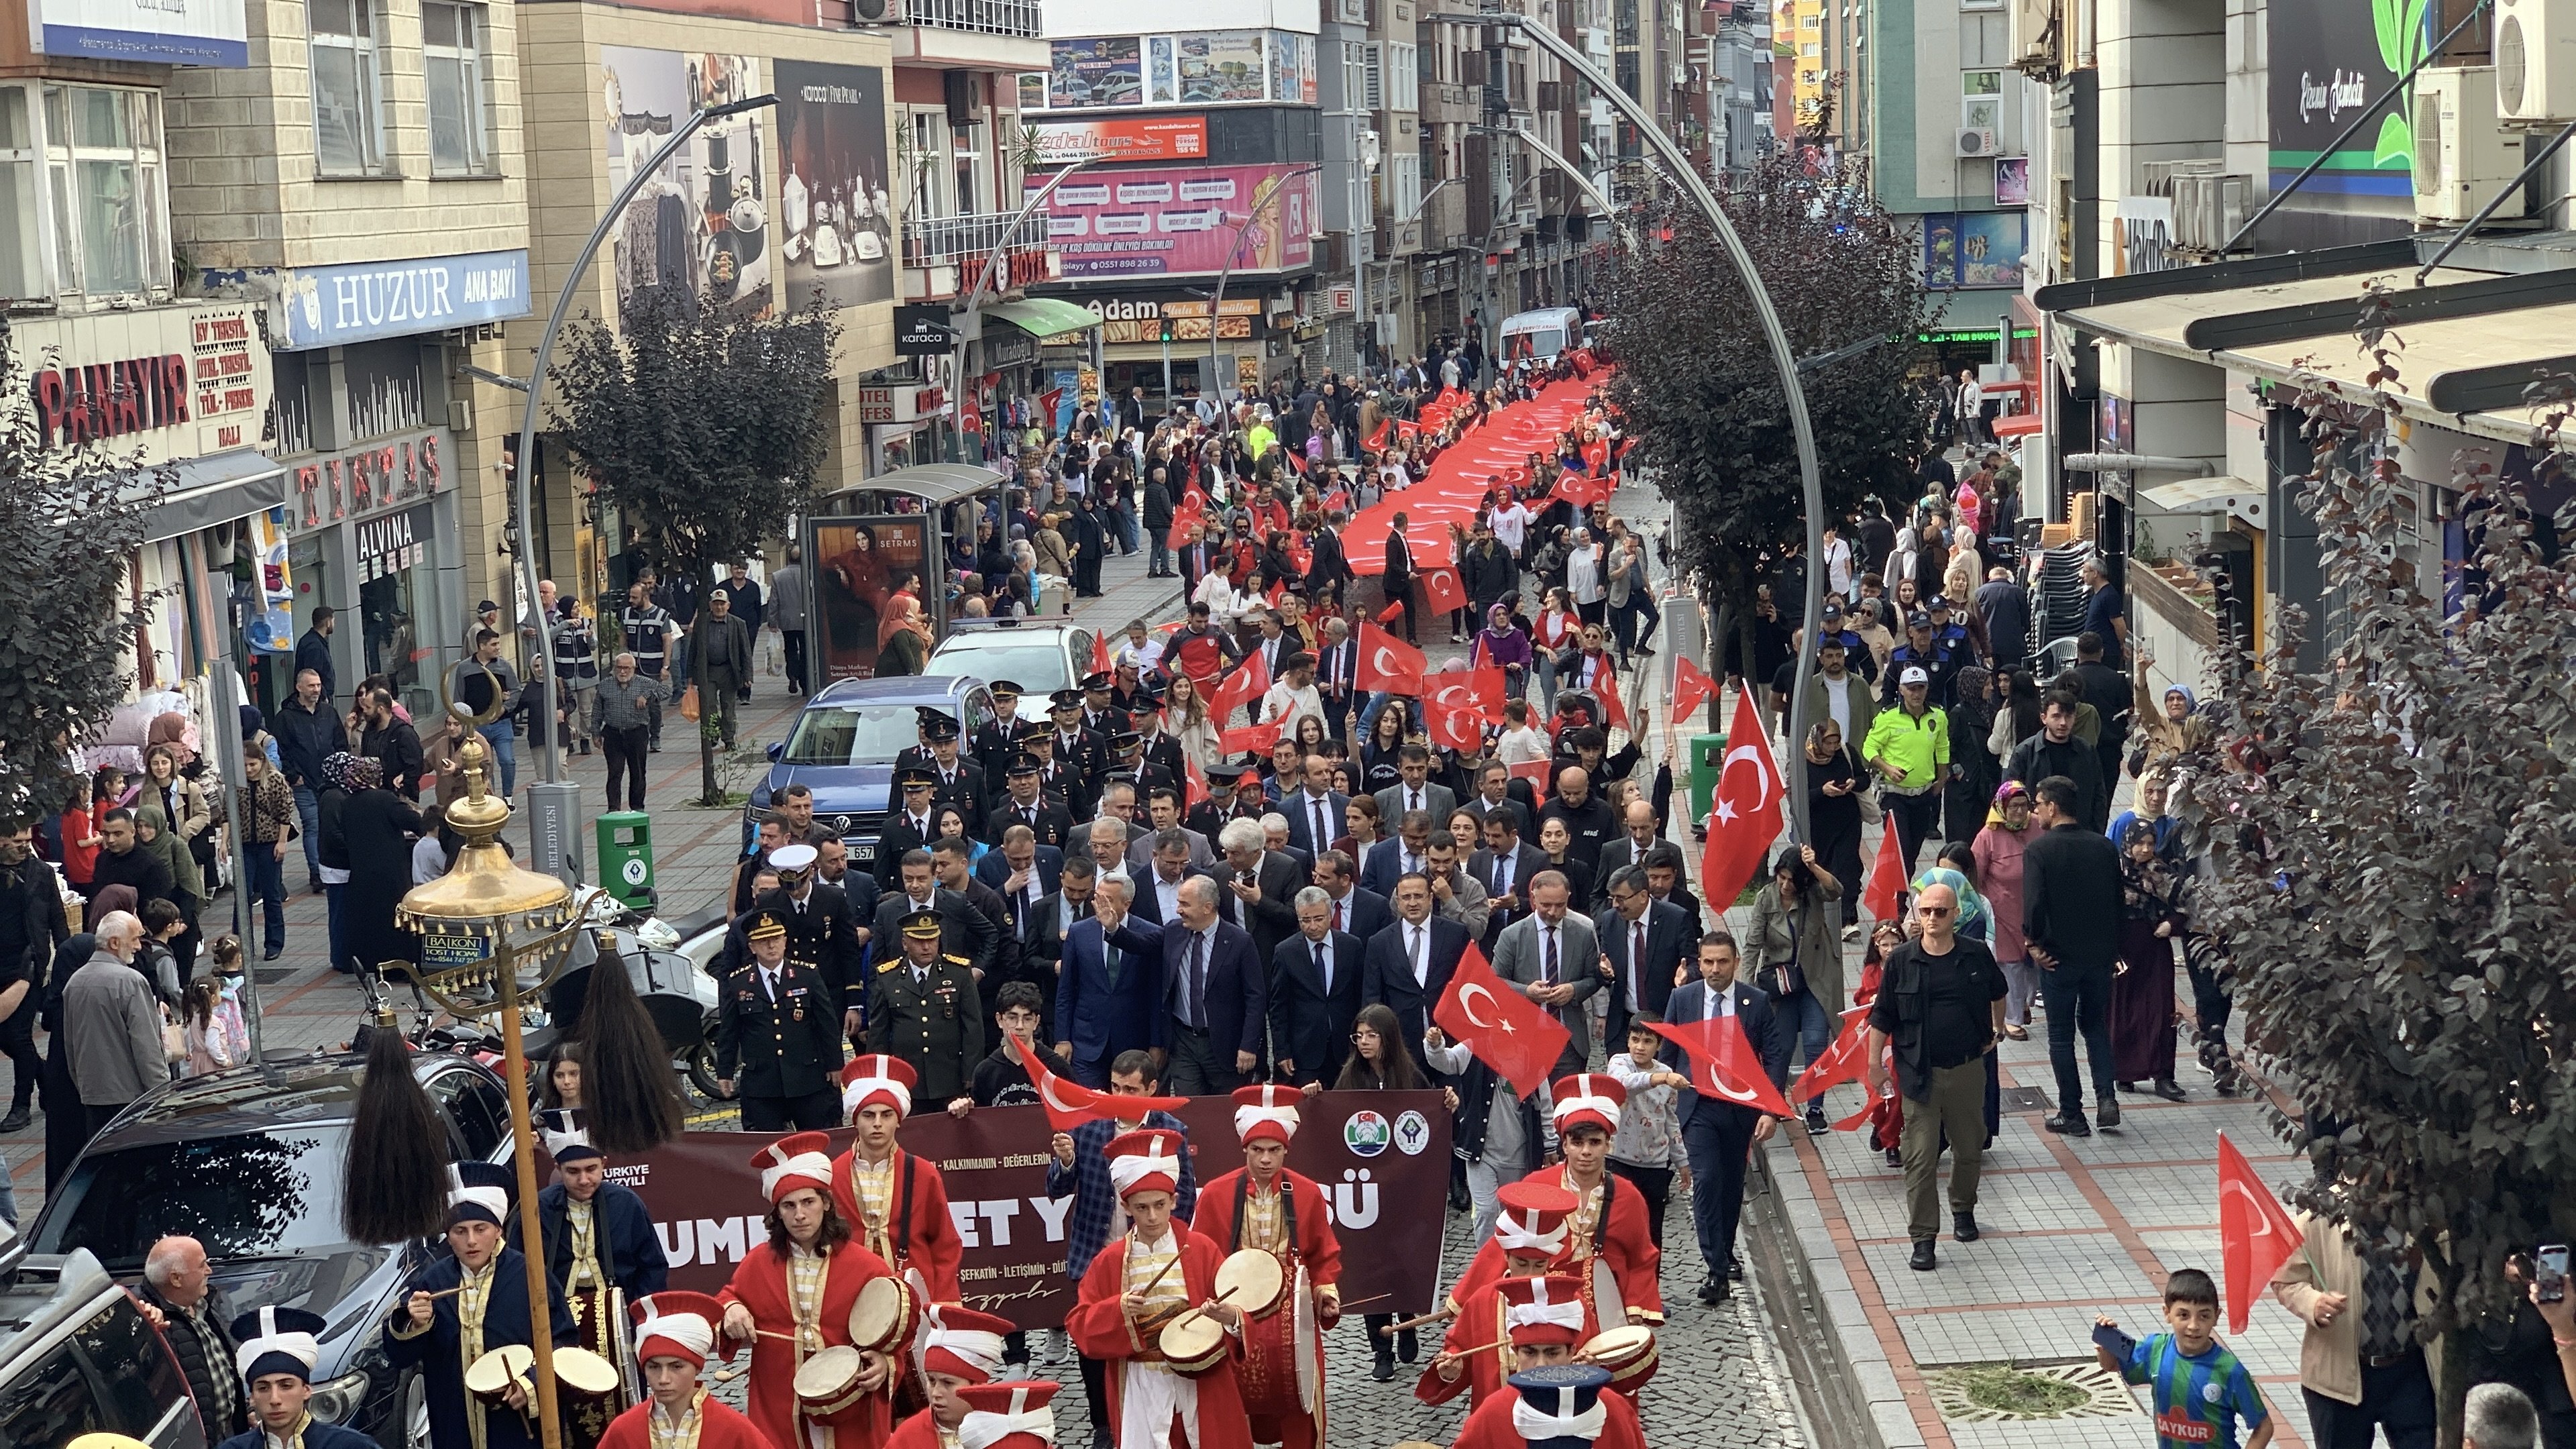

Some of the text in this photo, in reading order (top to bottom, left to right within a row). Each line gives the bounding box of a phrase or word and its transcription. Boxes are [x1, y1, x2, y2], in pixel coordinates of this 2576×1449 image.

[1093, 136, 1134, 148] tours
[1083, 239, 1112, 253] DÖKÜLME
[1142, 239, 1173, 250] BAKIMLAR
[1119, 260, 1136, 268] 898
[1137, 260, 1149, 268] 26
[1150, 259, 1160, 267] 39
[464, 260, 516, 303] ANA BAYİ
[333, 268, 453, 329] HUZUR
[211, 316, 249, 340] TEKSTİL
[902, 331, 942, 343] karaca
[996, 337, 1031, 364] Muradoğlu
[219, 350, 252, 375] TEKSTİL
[31, 353, 191, 448] PANAYIR
[225, 388, 254, 411] PERDE
[218, 425, 241, 448] HALI
[880, 539, 917, 548] SETRMS
[544, 805, 559, 868] BELEDİYESİ
[855, 847, 873, 859] 657
[943, 1157, 997, 1171] KALKINMANIN
[1004, 1151, 1052, 1169] DEĞERLERİN
[960, 1265, 998, 1283] ŞEFKATİN
[1004, 1261, 1046, 1278] İLETİŞİMİN
